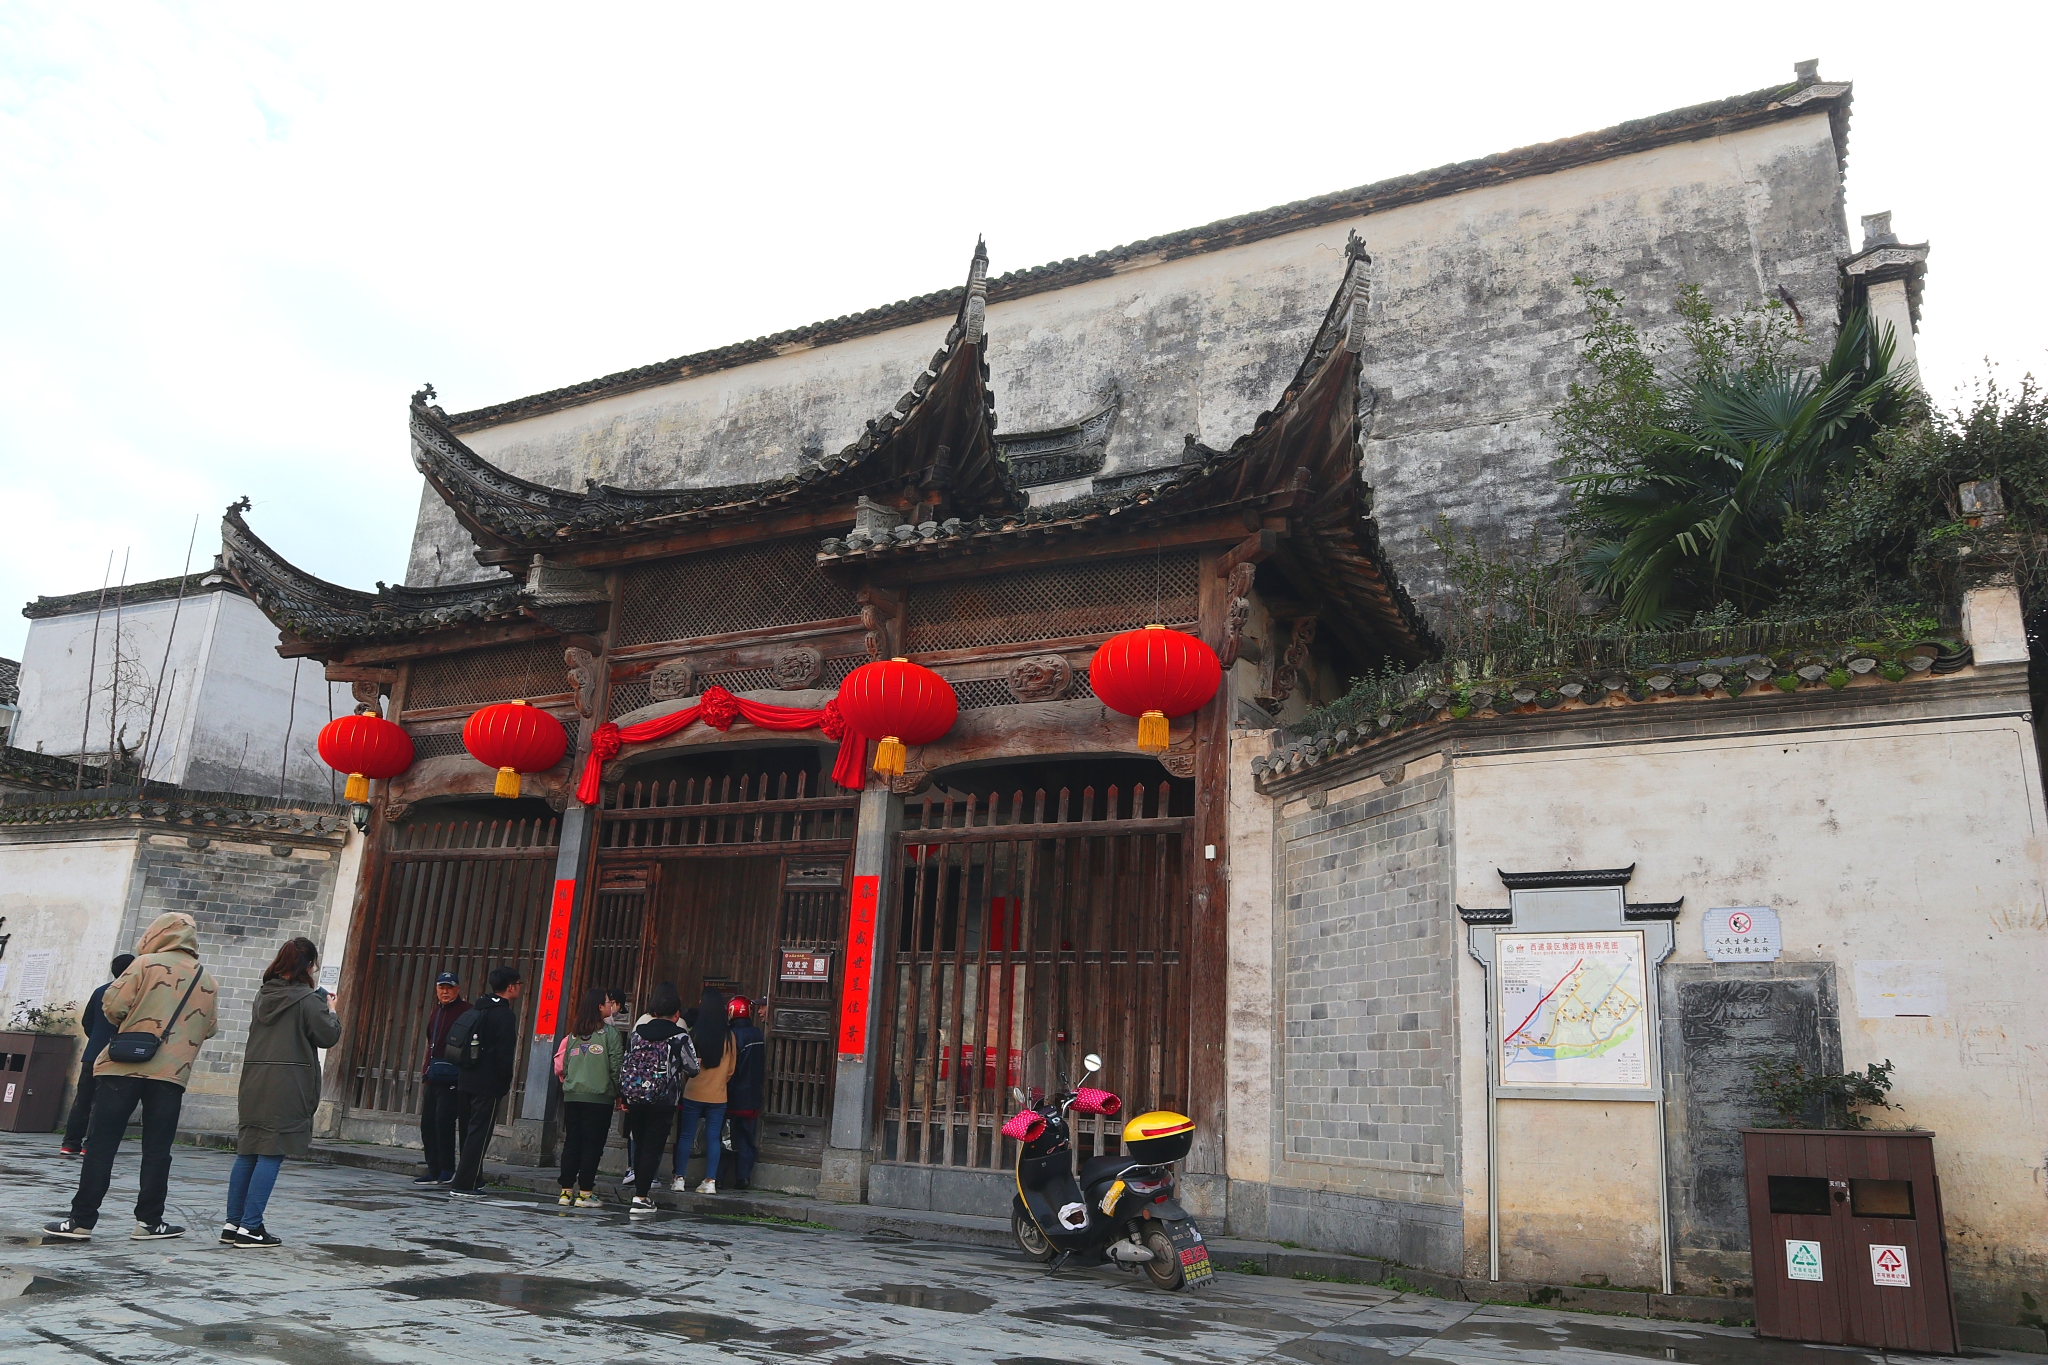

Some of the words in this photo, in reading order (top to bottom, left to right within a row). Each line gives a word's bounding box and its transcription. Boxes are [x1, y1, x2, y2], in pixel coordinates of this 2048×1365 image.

[1715, 936, 1769, 945] 人民生命至上
[1530, 941, 1619, 950] 西递景区旅游线路导览图
[1716, 946, 1771, 955] 火灾隐患必除
[786, 960, 808, 968] 敬爱堂
[60, 1221, 70, 1231] N
[156, 1224, 167, 1233] N
